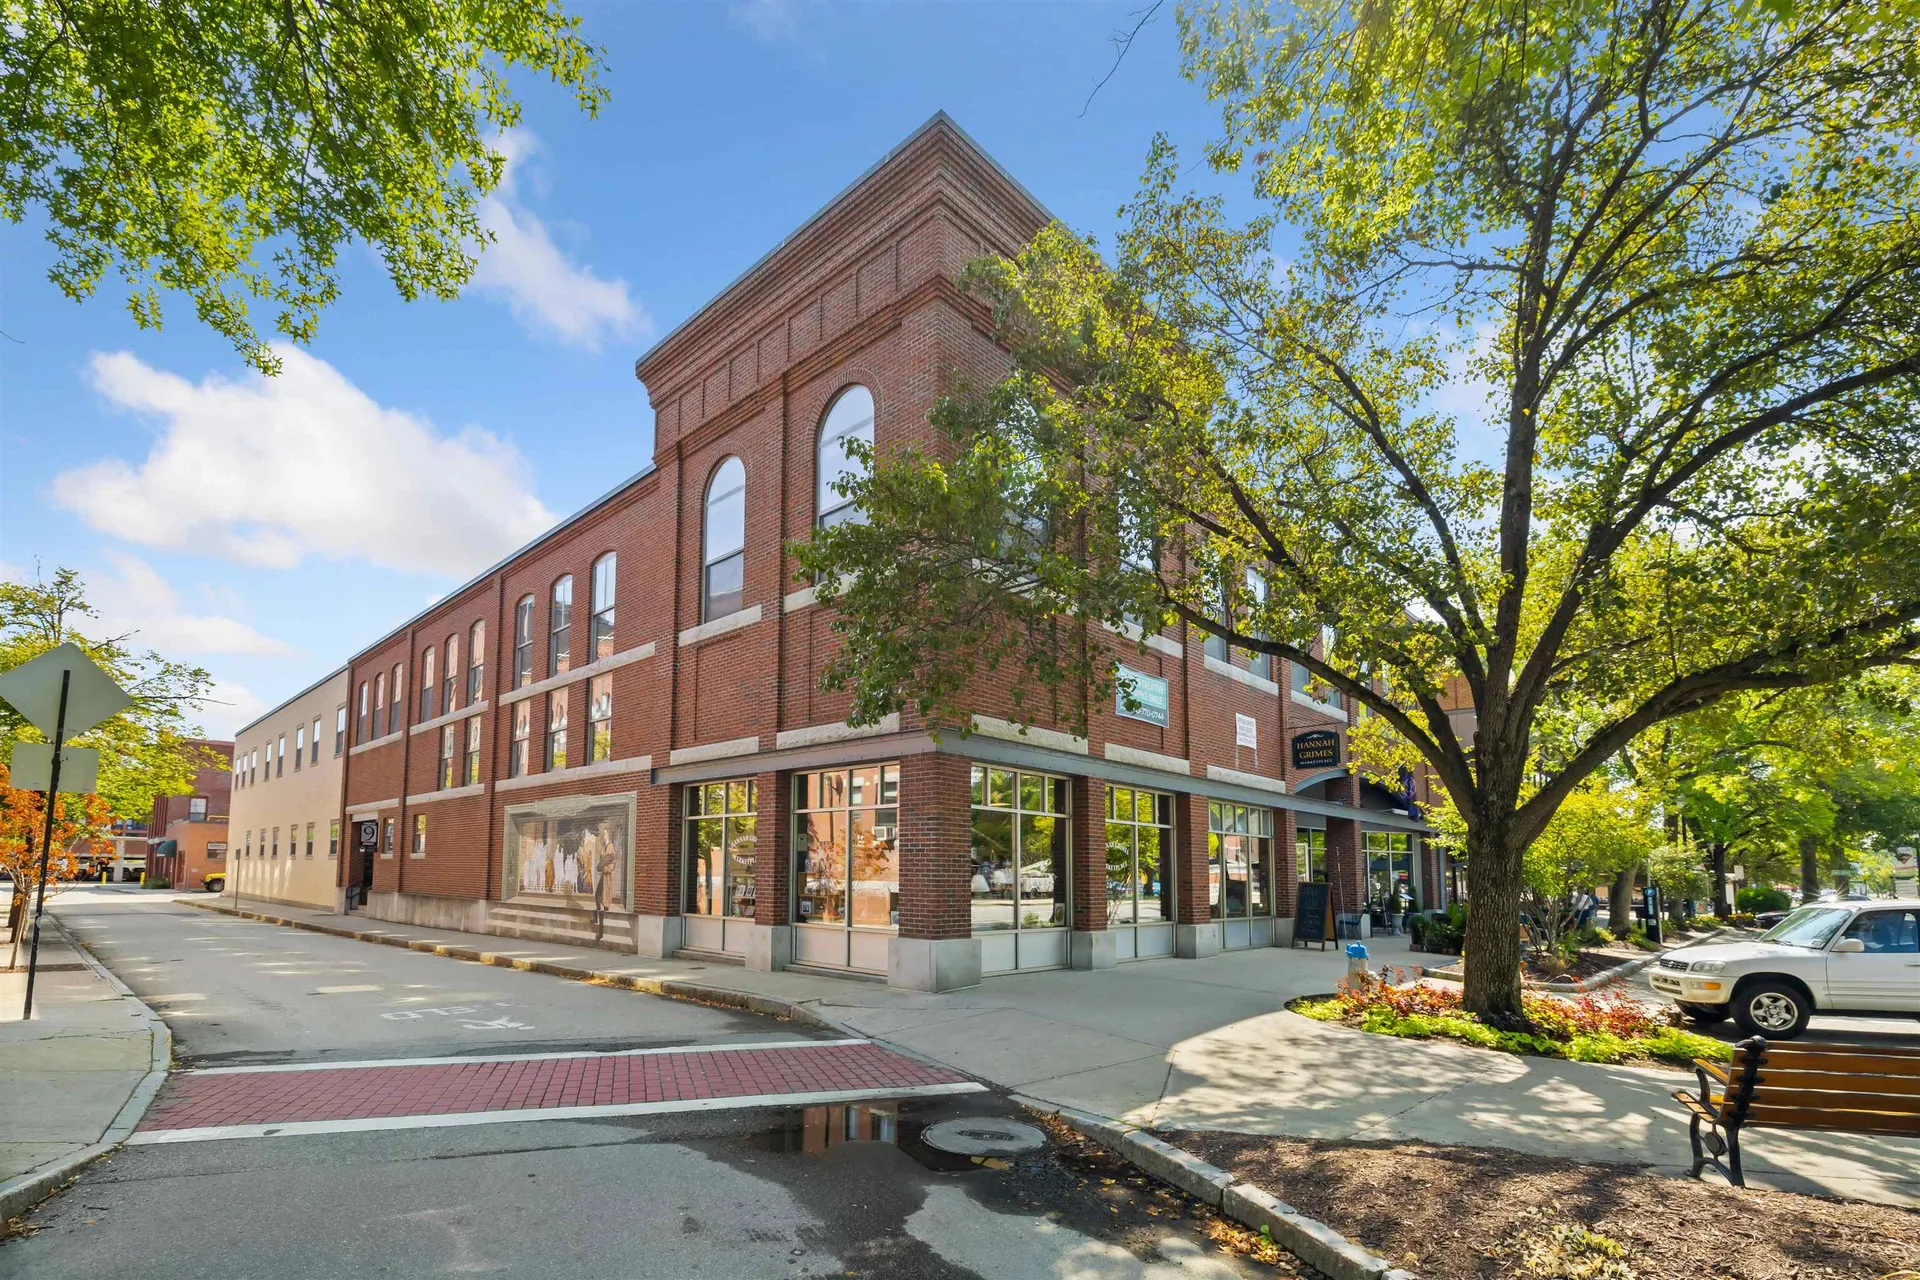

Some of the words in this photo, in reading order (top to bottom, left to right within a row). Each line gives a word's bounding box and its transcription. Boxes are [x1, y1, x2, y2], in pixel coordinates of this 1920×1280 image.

[1297, 739, 1335, 749] HANNAH
[1299, 749, 1333, 758] GRIMES
[364, 826, 374, 840] 9
